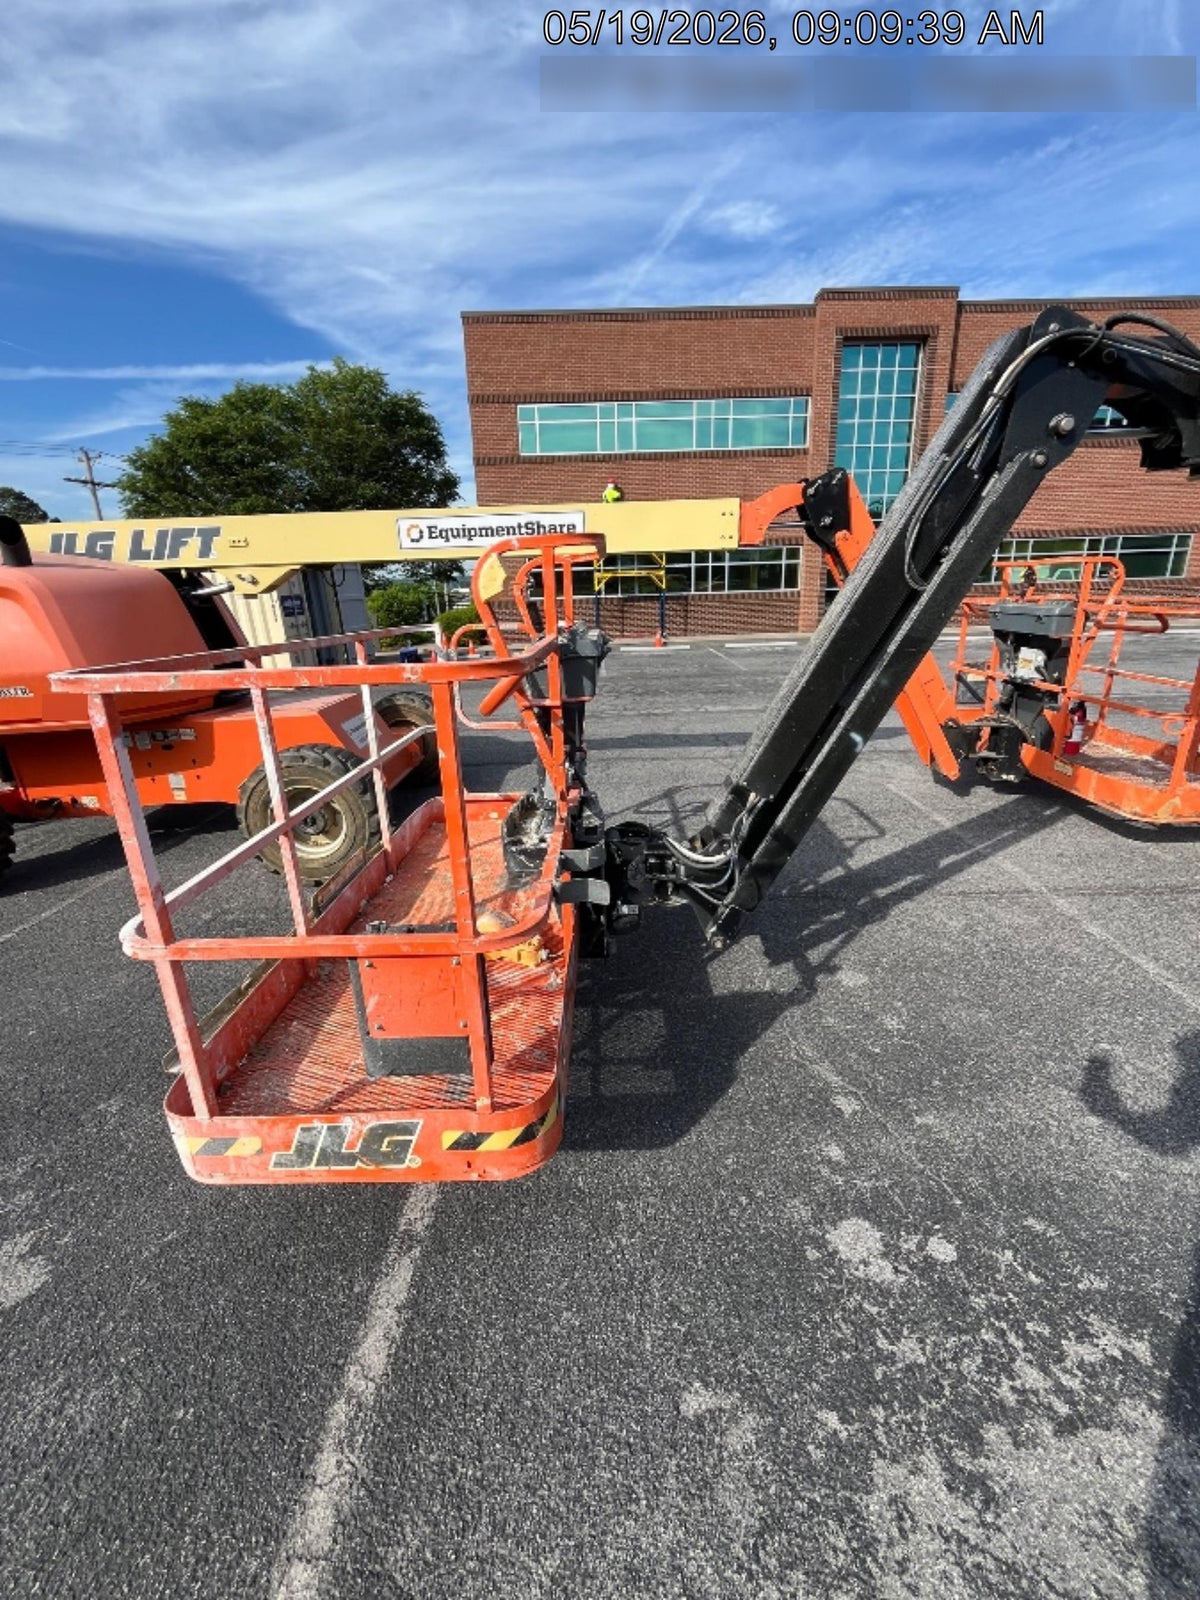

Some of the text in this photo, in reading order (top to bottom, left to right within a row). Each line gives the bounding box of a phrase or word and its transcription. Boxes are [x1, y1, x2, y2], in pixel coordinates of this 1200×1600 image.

[128, 526, 222, 561] LIFT
[426, 520, 577, 543] EquipmentShare
[269, 1119, 423, 1170] JLG
